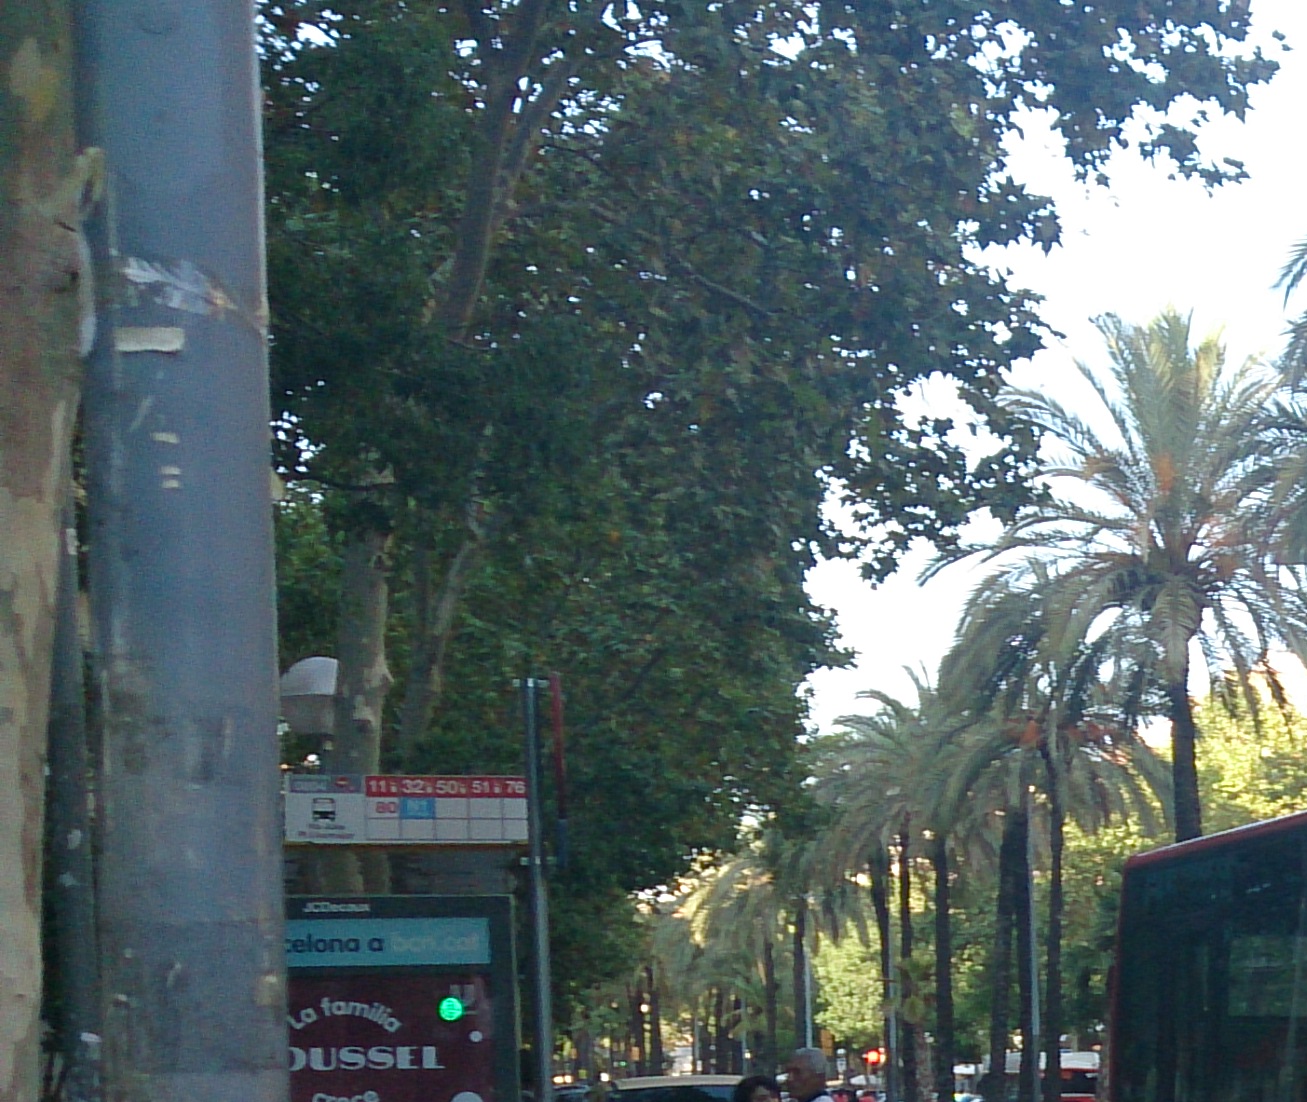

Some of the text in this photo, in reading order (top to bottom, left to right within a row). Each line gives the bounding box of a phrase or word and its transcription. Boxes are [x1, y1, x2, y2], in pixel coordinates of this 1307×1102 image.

[368, 779, 526, 794] 11 32 50 51 76
[375, 801, 397, 814] 80
[368, 937, 384, 952] a
[286, 996, 402, 1033] La familia
[289, 1046, 446, 1071] OUSSEL
